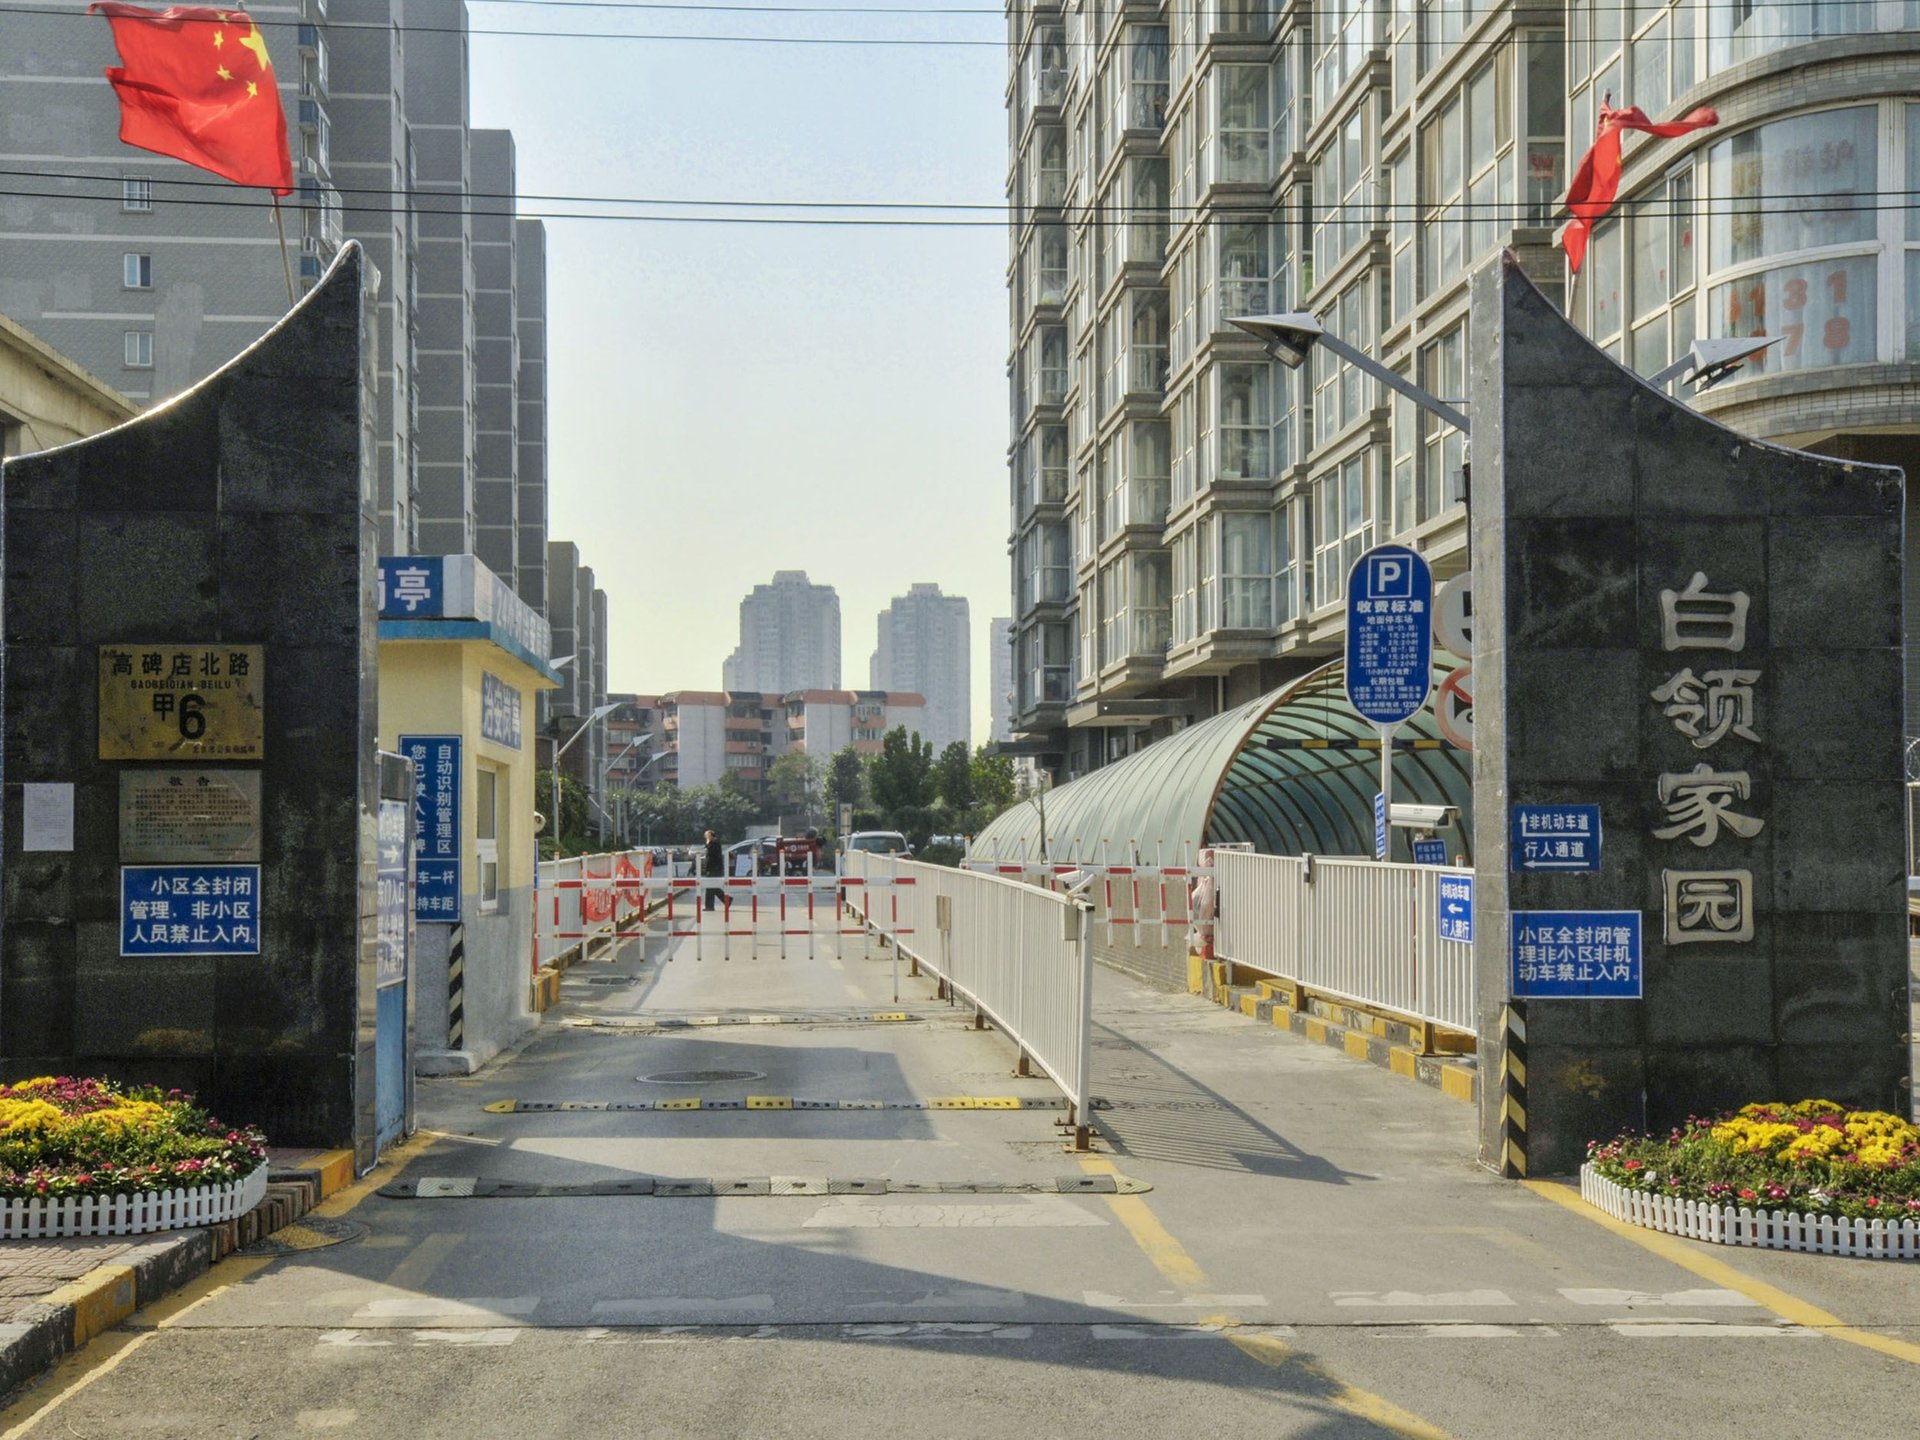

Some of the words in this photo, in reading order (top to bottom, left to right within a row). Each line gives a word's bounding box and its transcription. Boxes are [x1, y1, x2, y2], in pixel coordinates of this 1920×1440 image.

[1378, 561, 1401, 592] P
[378, 566, 431, 612] 亭
[1356, 600, 1424, 614] 收费标准
[112, 652, 250, 676] 高碑店北路
[201, 680, 231, 690] BEILU
[1650, 571, 1764, 946] 白领家园
[436, 744, 453, 854] 自动识别管理区
[1529, 814, 1589, 830] 非机动车道
[1524, 841, 1584, 858] 行人通道
[151, 876, 251, 895] 小区全封闭
[417, 871, 455, 885] 车一杆
[416, 896, 455, 911] 持车距
[1519, 926, 1631, 945] 小区全封闭管
[1519, 945, 1632, 963] 理非小区非机
